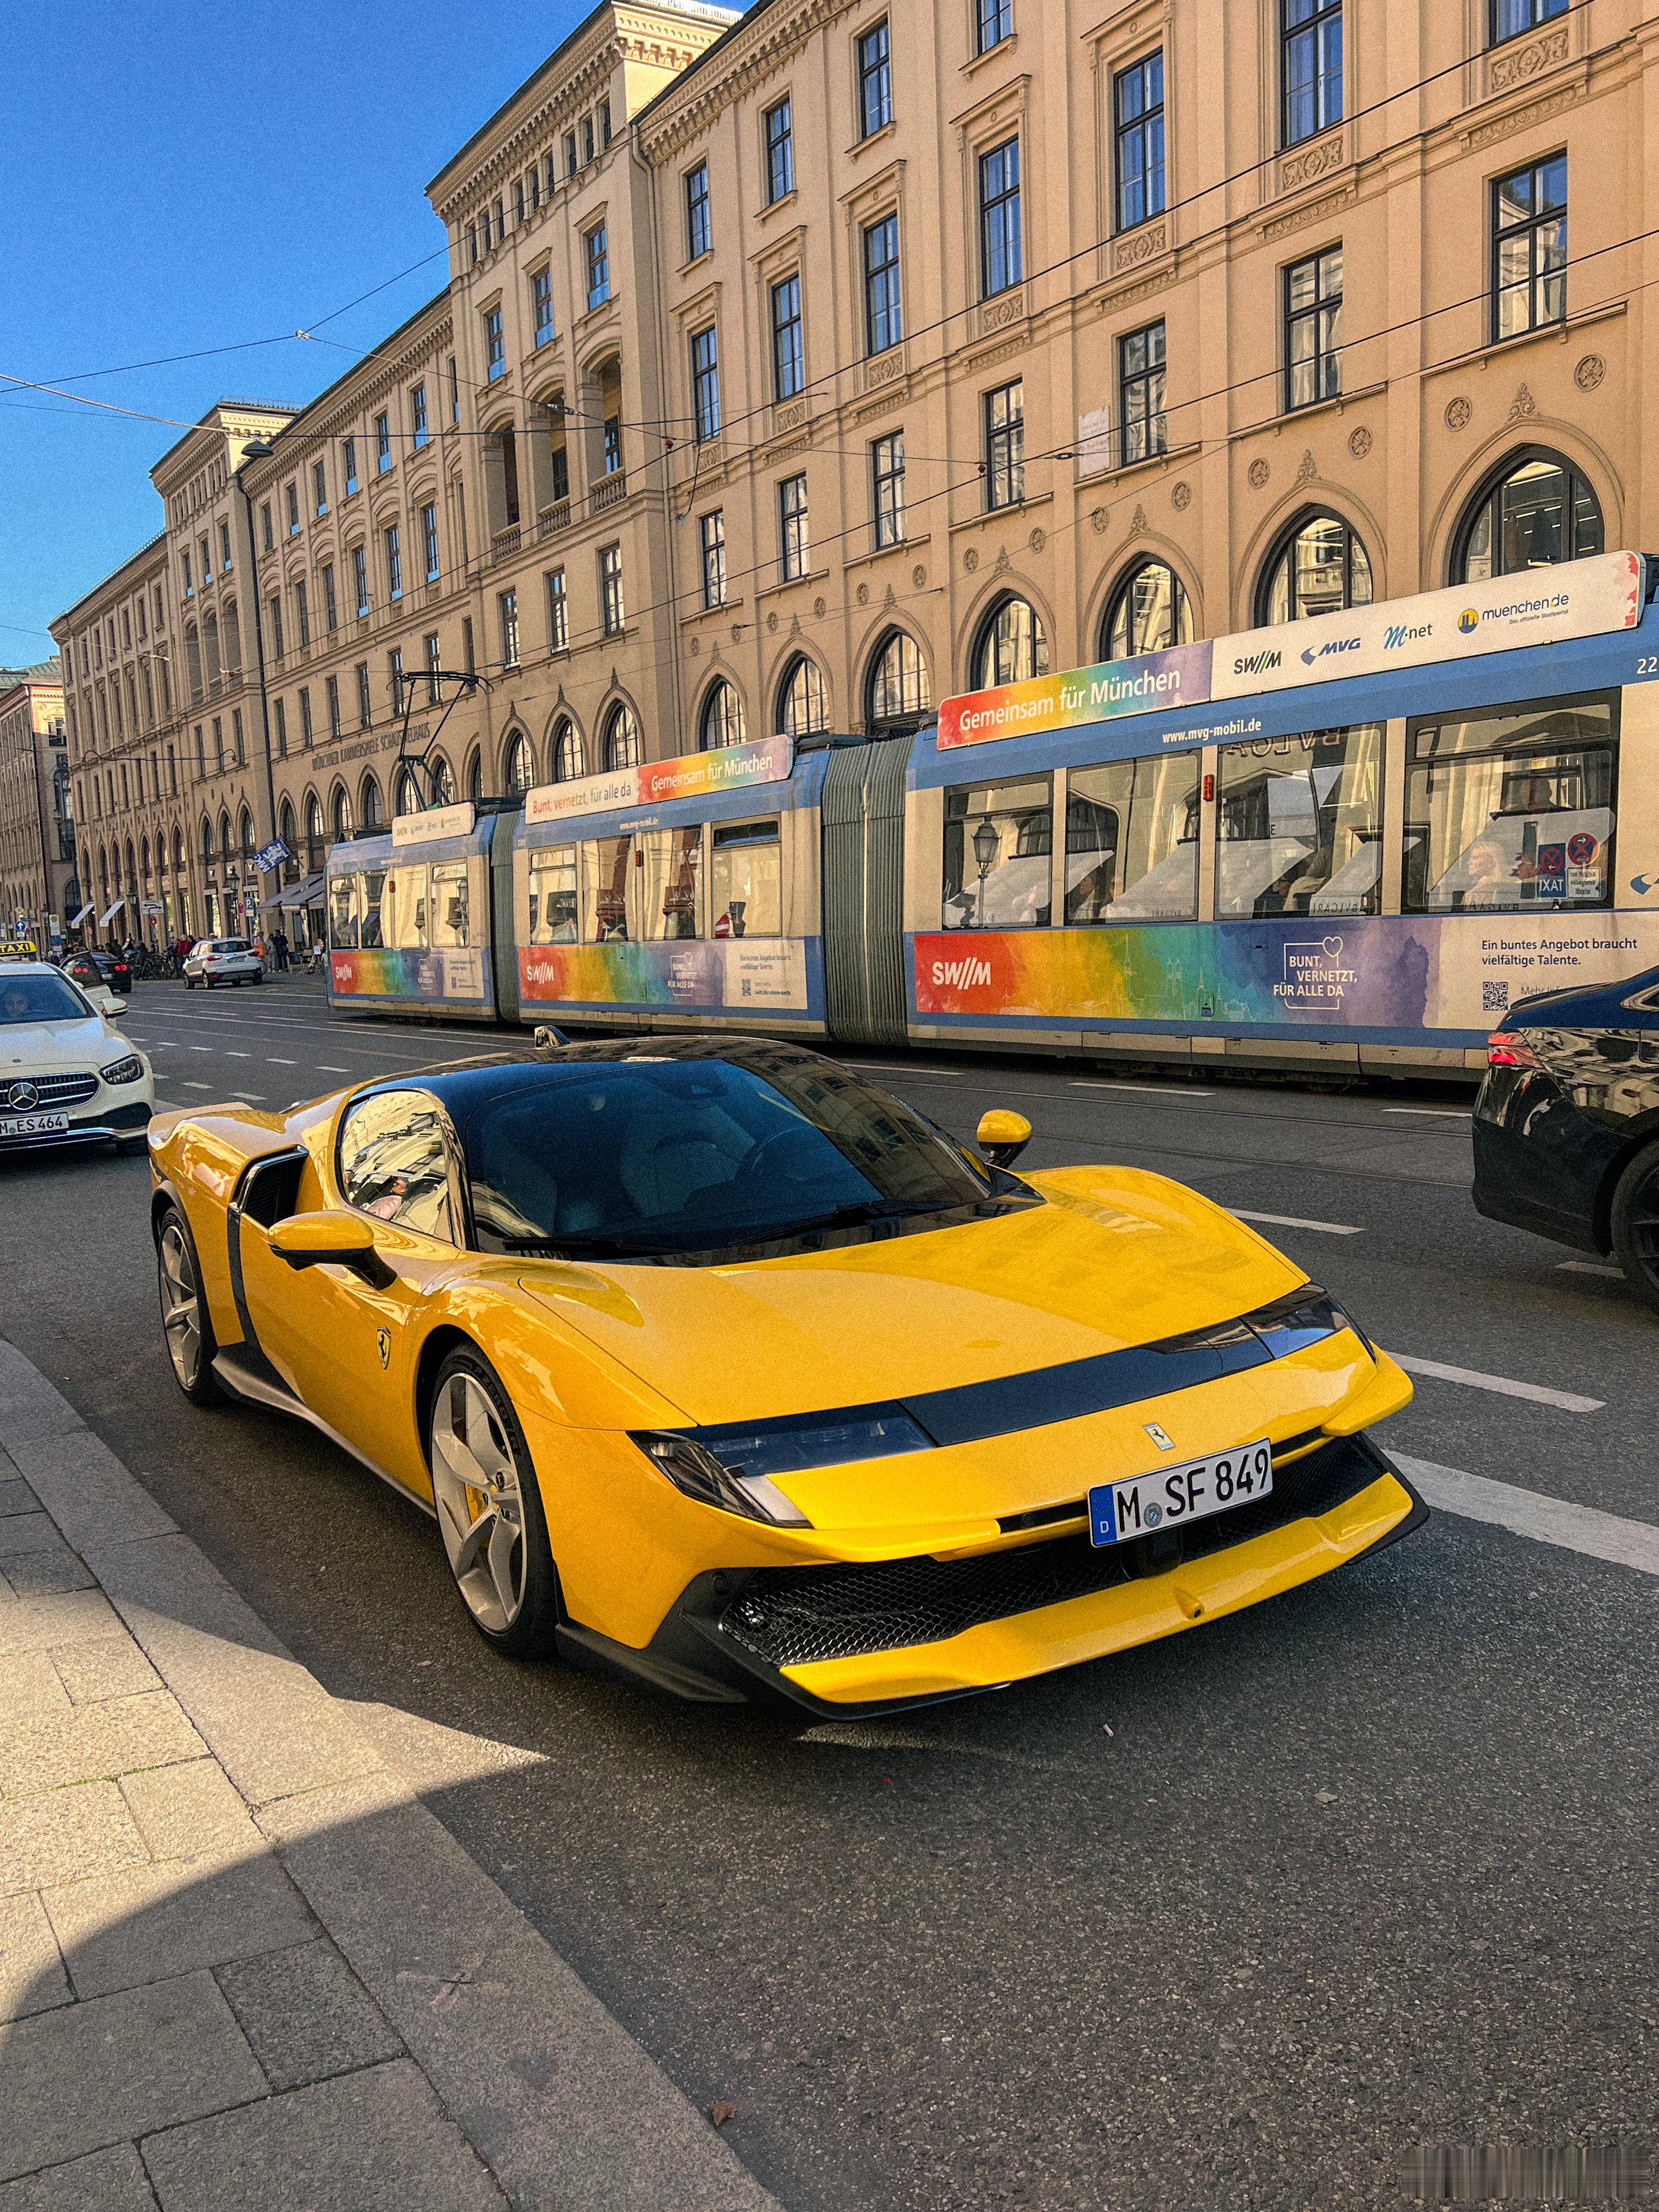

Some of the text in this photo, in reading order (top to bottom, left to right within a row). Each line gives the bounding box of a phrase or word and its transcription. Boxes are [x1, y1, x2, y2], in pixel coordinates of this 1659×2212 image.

[1482, 594, 1569, 621] muenchen.de
[1317, 638, 1361, 656] MVG
[960, 670, 1181, 731] Gemeinsam für München
[1163, 718, 1262, 743] www.mvg-mobil.de
[652, 754, 773, 791] Gemeinsam für München
[533, 782, 631, 814] Bunt, vernetzt, für alle da
[0, 943, 29, 953] TAXI
[1482, 938, 1638, 952] Ein buntes Angebot braucht
[1289, 956, 1323, 968] BUNT,
[1482, 955, 1581, 968] vielfältige Talente.
[1296, 970, 1358, 983] VERNETZT,
[1274, 981, 1345, 997] FÜR ALLE DA
[1521, 986, 1545, 995] Mehr
[17, 1119, 35, 1133] ES
[38, 1115, 63, 1130] 464
[1100, 1448, 1268, 1534] D M SF 849
